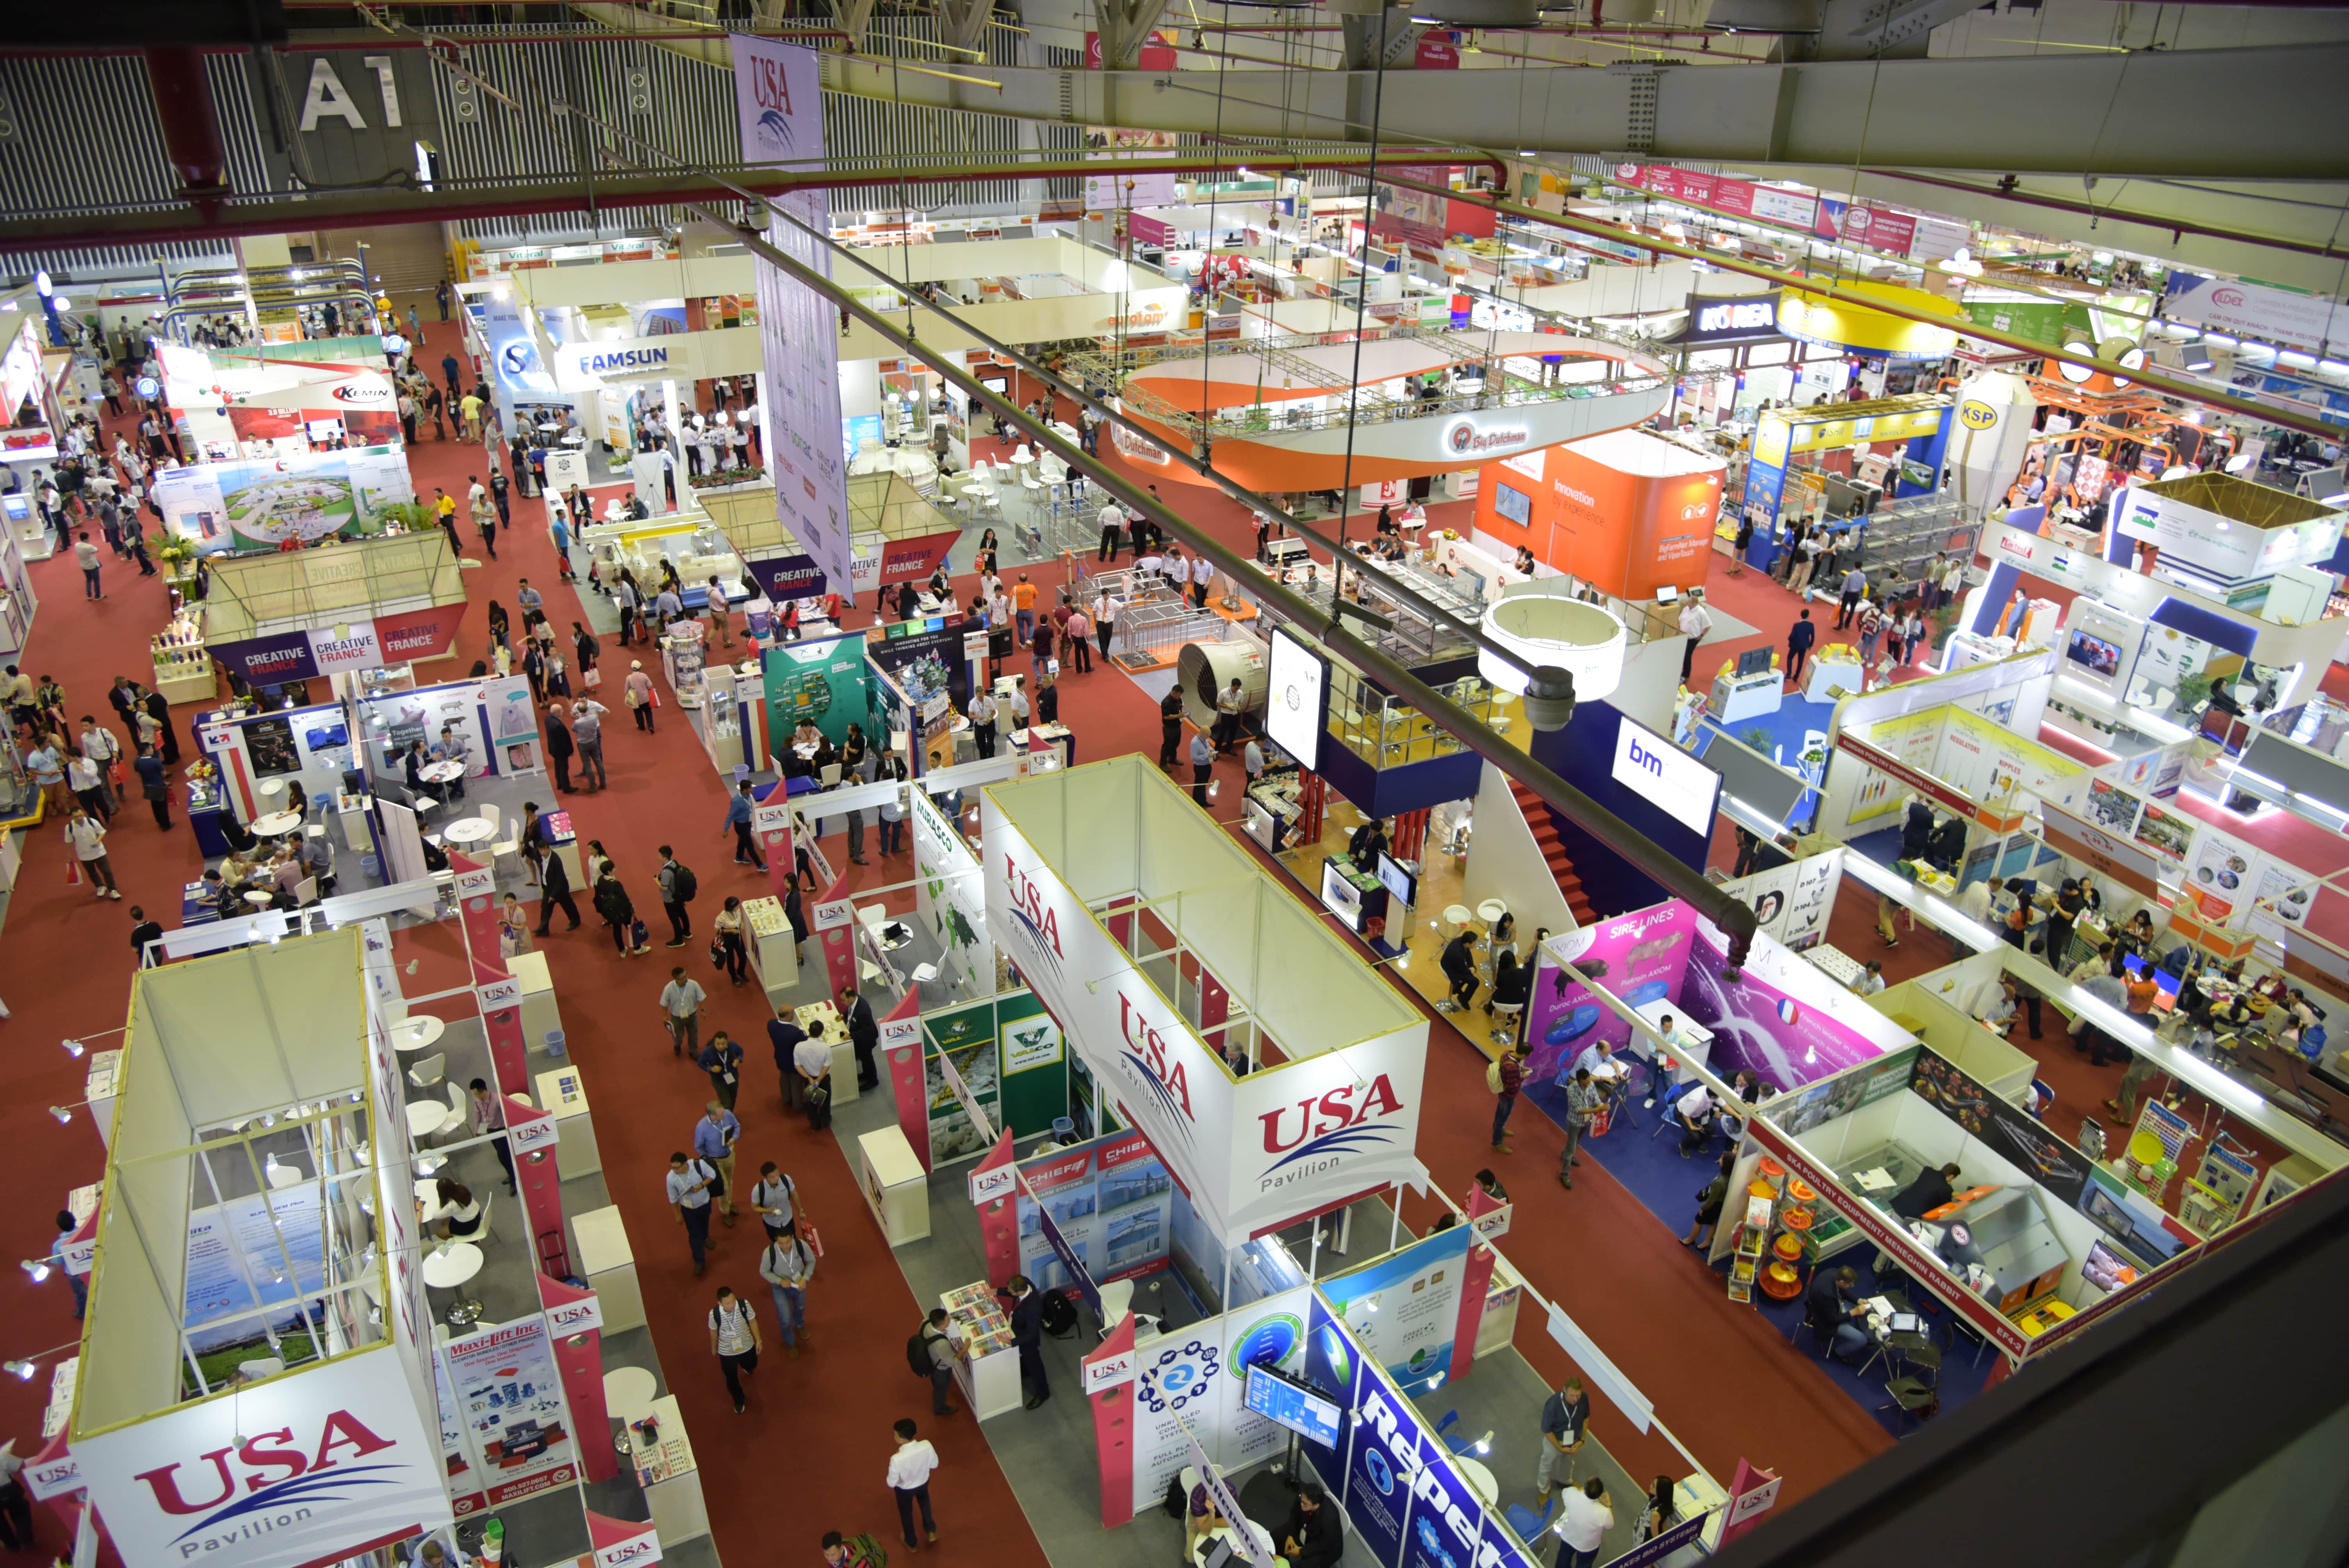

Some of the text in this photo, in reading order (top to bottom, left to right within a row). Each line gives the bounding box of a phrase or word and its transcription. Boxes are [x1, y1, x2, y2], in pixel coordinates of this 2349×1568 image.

[300, 56, 402, 131] A1
[750, 55, 793, 116] USA
[1700, 304, 1774, 331] KOREA
[580, 347, 668, 372] FAMSUN
[340, 388, 388, 398] KEMIN
[1962, 405, 1993, 424] KSP
[1125, 435, 1162, 459] Dutchman
[1473, 431, 1525, 449] Big Dutchman
[1554, 479, 1594, 508] Innovation
[1552, 494, 1606, 528] by experience.
[774, 567, 822, 583] CREATIVE
[886, 559, 925, 574] FRANCE
[774, 577, 813, 591] FRANCE
[387, 634, 433, 652] FRANCE
[895, 638, 920, 646] INNOVATING
[931, 637, 953, 646] EVERYONE
[245, 647, 306, 666] CREATIVE
[320, 647, 367, 663] FRANCE
[250, 659, 299, 675] FRANCE
[391, 726, 423, 737] Together
[1908, 734, 1933, 747] PIPE LINES
[1950, 734, 1980, 755] REGULATORS
[1629, 735, 1663, 778] bm
[1843, 739, 1864, 755] KUMSAN
[1865, 750, 1889, 770] POULTRY
[1890, 761, 1922, 786] EQUIPMENTS
[1923, 781, 1935, 793] LLC
[1998, 759, 2021, 775] NIPPLES
[759, 810, 784, 821] USA
[918, 800, 952, 852] MIRASCO
[806, 838, 828, 877] MIRASCO
[460, 874, 489, 887] USA
[1340, 887, 1356, 904] KIMIN
[818, 905, 846, 920] USA
[1005, 853, 1064, 961] USA
[1009, 914, 1040, 961] Pavilion
[1610, 920, 1638, 939] SIRE
[868, 938, 894, 985] MIRASCO
[1621, 964, 1672, 987] Pietrain AXIOM
[484, 986, 515, 1000] USA
[1549, 1001, 1572, 1013] Duroc
[885, 1024, 915, 1039] USA
[1800, 1012, 1820, 1028] French
[1821, 1023, 1843, 1043] leader
[1117, 990, 1195, 1123] USA
[1121, 1057, 1162, 1117] Pavilion
[1258, 1073, 1404, 1154] USA
[516, 1123, 551, 1140] USA
[1106, 1141, 1147, 1160] CHIEF
[1027, 1164, 1073, 1184] CHIEF
[1112, 1159, 1142, 1171] COMMERCIAL
[1261, 1156, 1339, 1193] Pavilion
[977, 1172, 1010, 1190] USA
[1037, 1180, 1084, 1199] FARM SYSTEMS
[1478, 1214, 1506, 1231] USA
[1953, 1229, 1967, 1240] SKA
[1057, 1240, 1083, 1281] CHIEF AGRI
[1786, 1153, 2022, 1351] SKA POULTRY EQUIPMENT/ MENEGHIN RABBIT EF4-2
[553, 1306, 593, 1324] USA
[450, 1323, 540, 1357] Maxi-Lift Inc.
[452, 1354, 476, 1364] ELEVATOR
[519, 1333, 544, 1343] PRODUCTS
[474, 1353, 495, 1364] Source.
[508, 1342, 536, 1354] Shipment.
[496, 1352, 518, 1362] Invoice.
[1092, 1360, 1128, 1379] USA
[1155, 1409, 1201, 1430] UNRIALED
[513, 1441, 538, 1453] BUNDLES
[1241, 1437, 1277, 1454] SERVICES
[1242, 1431, 1276, 1449] TURNKEY
[134, 1409, 397, 1515] USA
[34, 1462, 79, 1484] USA
[501, 1481, 551, 1501] MAXILIFT.COM
[503, 1476, 547, 1494] 800.527.0657
[1741, 1489, 1771, 1509] USA
[1214, 1483, 1259, 1557] Repete
[180, 1507, 312, 1559] Pavilion
[606, 1541, 652, 1563] USA
[1618, 1524, 1698, 1568] AKES BIO SYSTEMS
